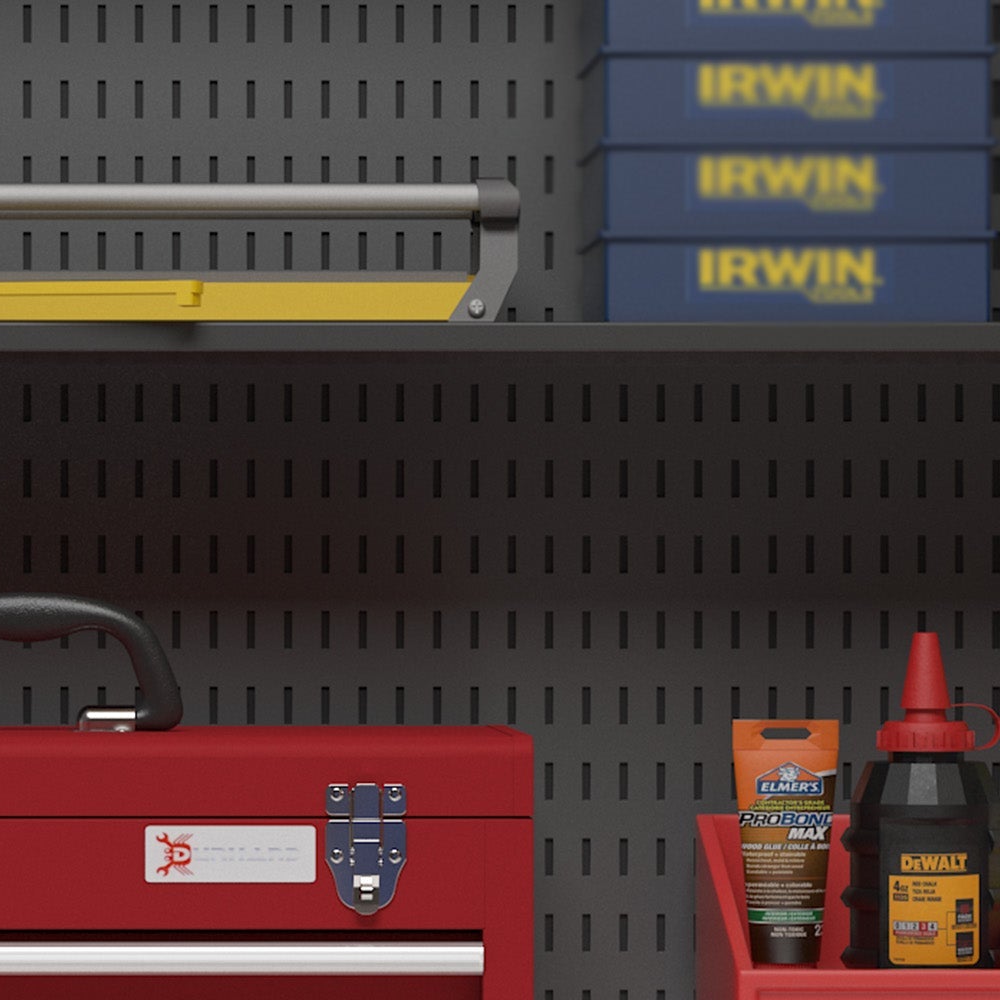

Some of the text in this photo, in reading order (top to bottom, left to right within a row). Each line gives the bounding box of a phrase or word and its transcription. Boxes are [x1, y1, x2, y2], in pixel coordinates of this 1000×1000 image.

[698, 63, 876, 106] IRWIN
[698, 155, 876, 198] IRWIN
[698, 248, 876, 290] IRWIN
[760, 782, 819, 792] ELMER'S
[787, 826, 829, 840] MAX
[901, 853, 967, 872] DEWALT
[893, 881, 900, 891] 4
